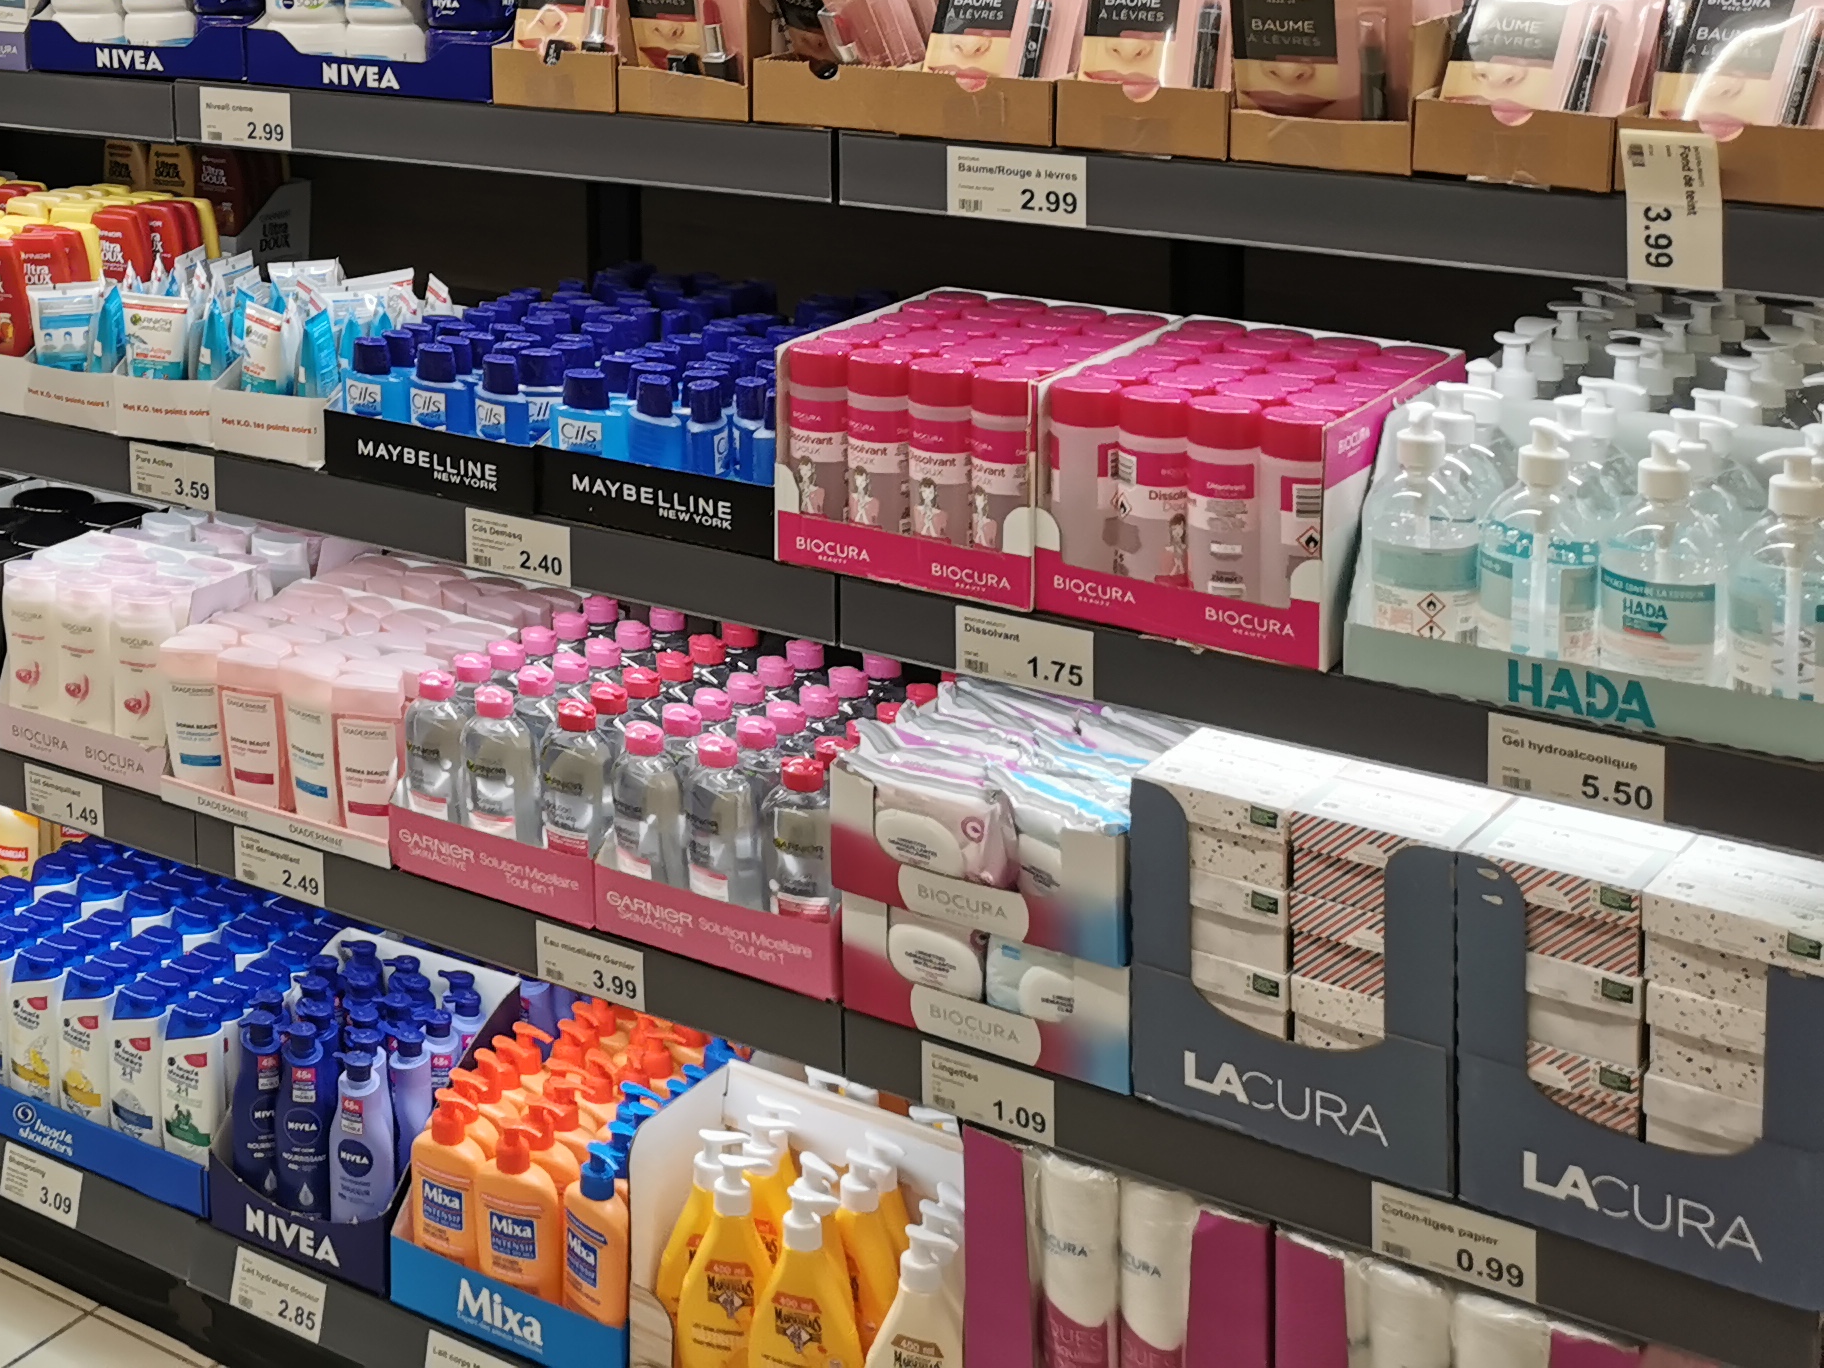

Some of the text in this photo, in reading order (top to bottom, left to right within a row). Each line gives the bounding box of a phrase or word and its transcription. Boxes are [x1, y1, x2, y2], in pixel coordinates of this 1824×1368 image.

[247, 122, 284, 141] 2.99
[958, 163, 1031, 178] Baume/Rouge
[1020, 189, 1077, 213] 2.99
[1643, 206, 1673, 269] 3.99
[559, 421, 596, 443] Cils
[135, 455, 152, 467] Pure
[175, 477, 209, 501] 3.59
[571, 475, 732, 518] MAYBELLINE
[658, 507, 732, 530] NEW YORK
[519, 551, 562, 577] 2.40
[796, 536, 870, 562] BIOCURA
[1204, 606, 1294, 638] BIOCURA
[1622, 597, 1668, 620] HADA
[964, 623, 1020, 642] Dissolvant
[1026, 655, 1083, 687] 1.75
[1507, 659, 1656, 728] HADA
[1502, 734, 1638, 772] Gel hydroalcoolique
[1581, 775, 1652, 810] 5.50
[66, 801, 99, 826] 1.49
[282, 869, 319, 895] 2.49
[606, 891, 694, 928] GARNIER
[592, 970, 636, 998] 3.99
[928, 1002, 1020, 1046] BIOCURA
[931, 1060, 978, 1083] Lingettes
[1184, 1051, 1389, 1147] LACURA
[992, 1100, 1046, 1131] 1.09
[39, 1186, 72, 1215] 3.09
[1523, 1152, 1762, 1263] LACURA
[246, 1205, 340, 1267] NIVEA
[1456, 1249, 1524, 1288] 0.99
[277, 1299, 316, 1330] 2.85
[456, 1277, 543, 1347] Mixa
